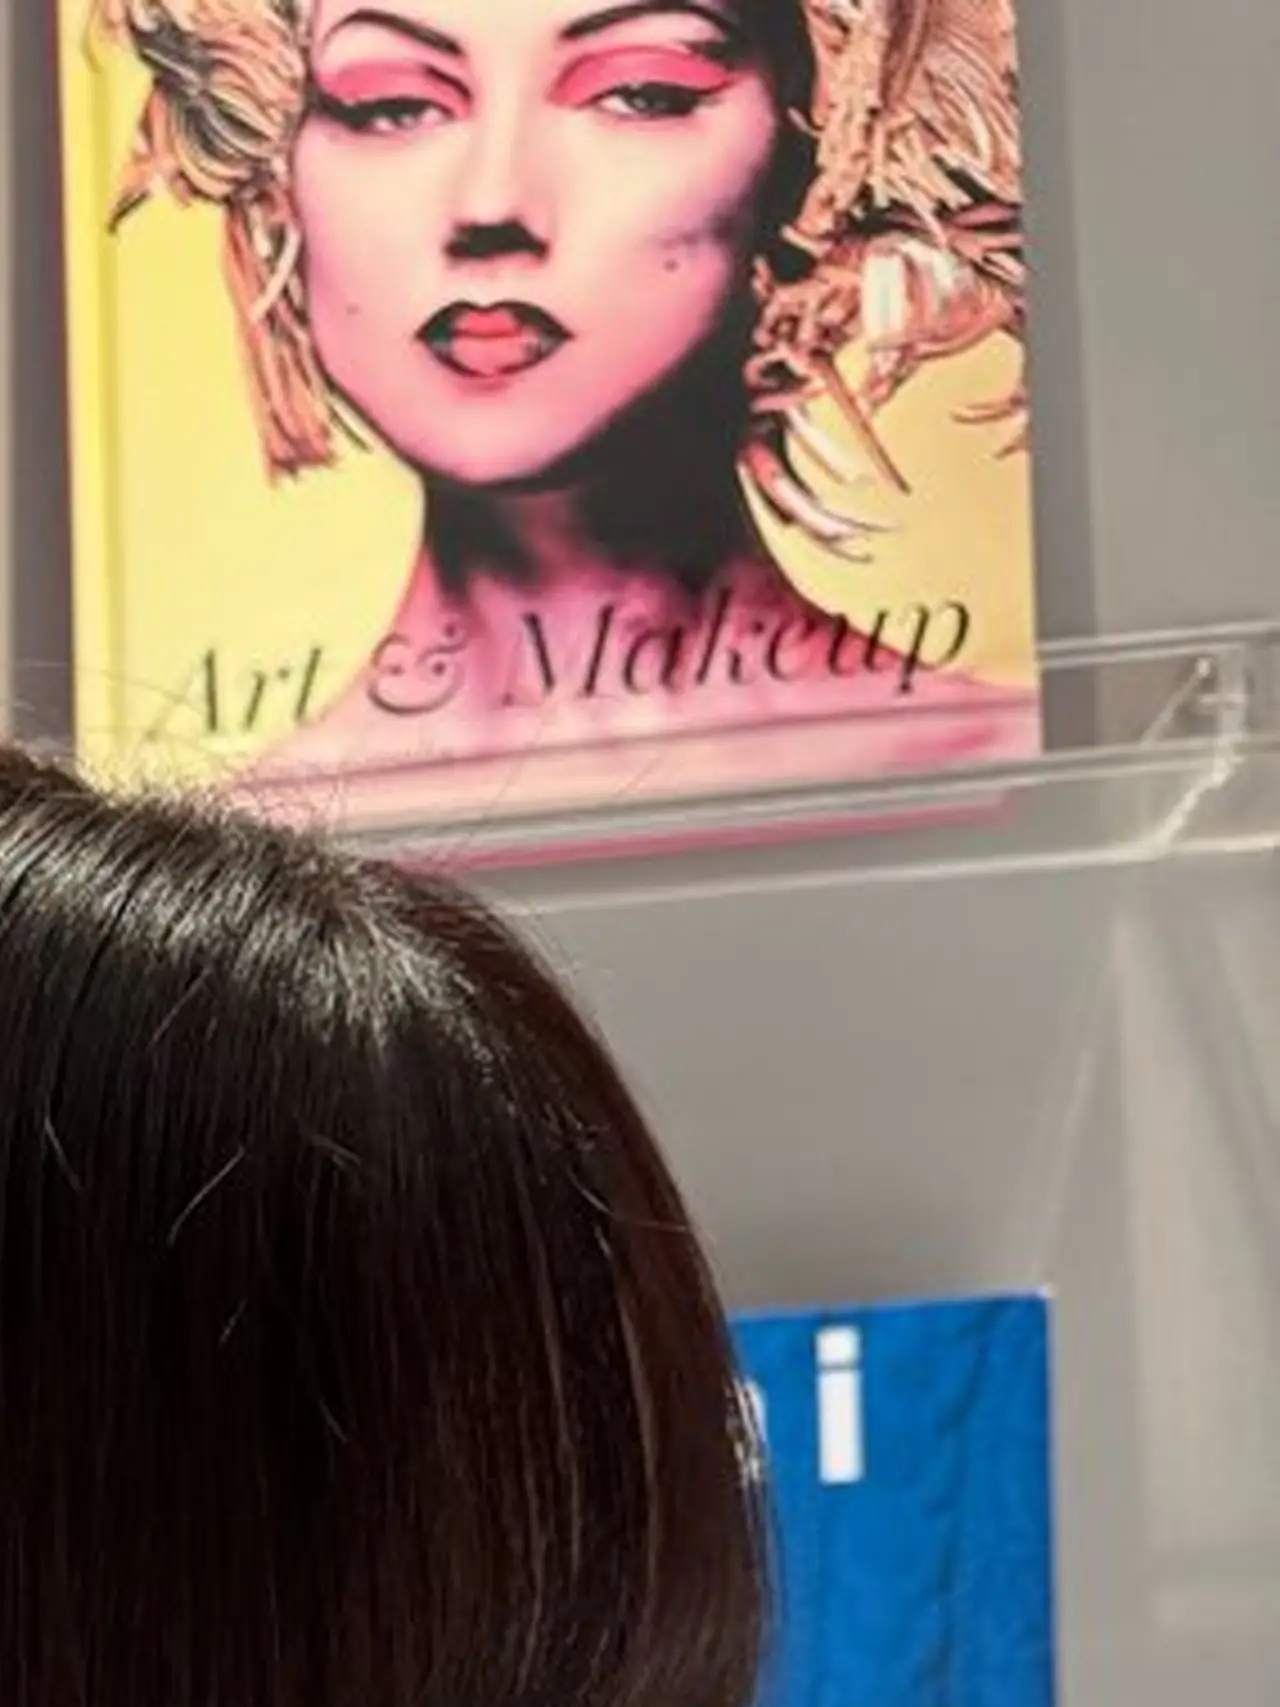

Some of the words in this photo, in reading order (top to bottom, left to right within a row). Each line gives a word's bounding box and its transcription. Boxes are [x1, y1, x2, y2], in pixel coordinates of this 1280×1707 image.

[144, 644, 334, 742] Art
[368, 620, 472, 717] &
[500, 587, 971, 706] Makeup
